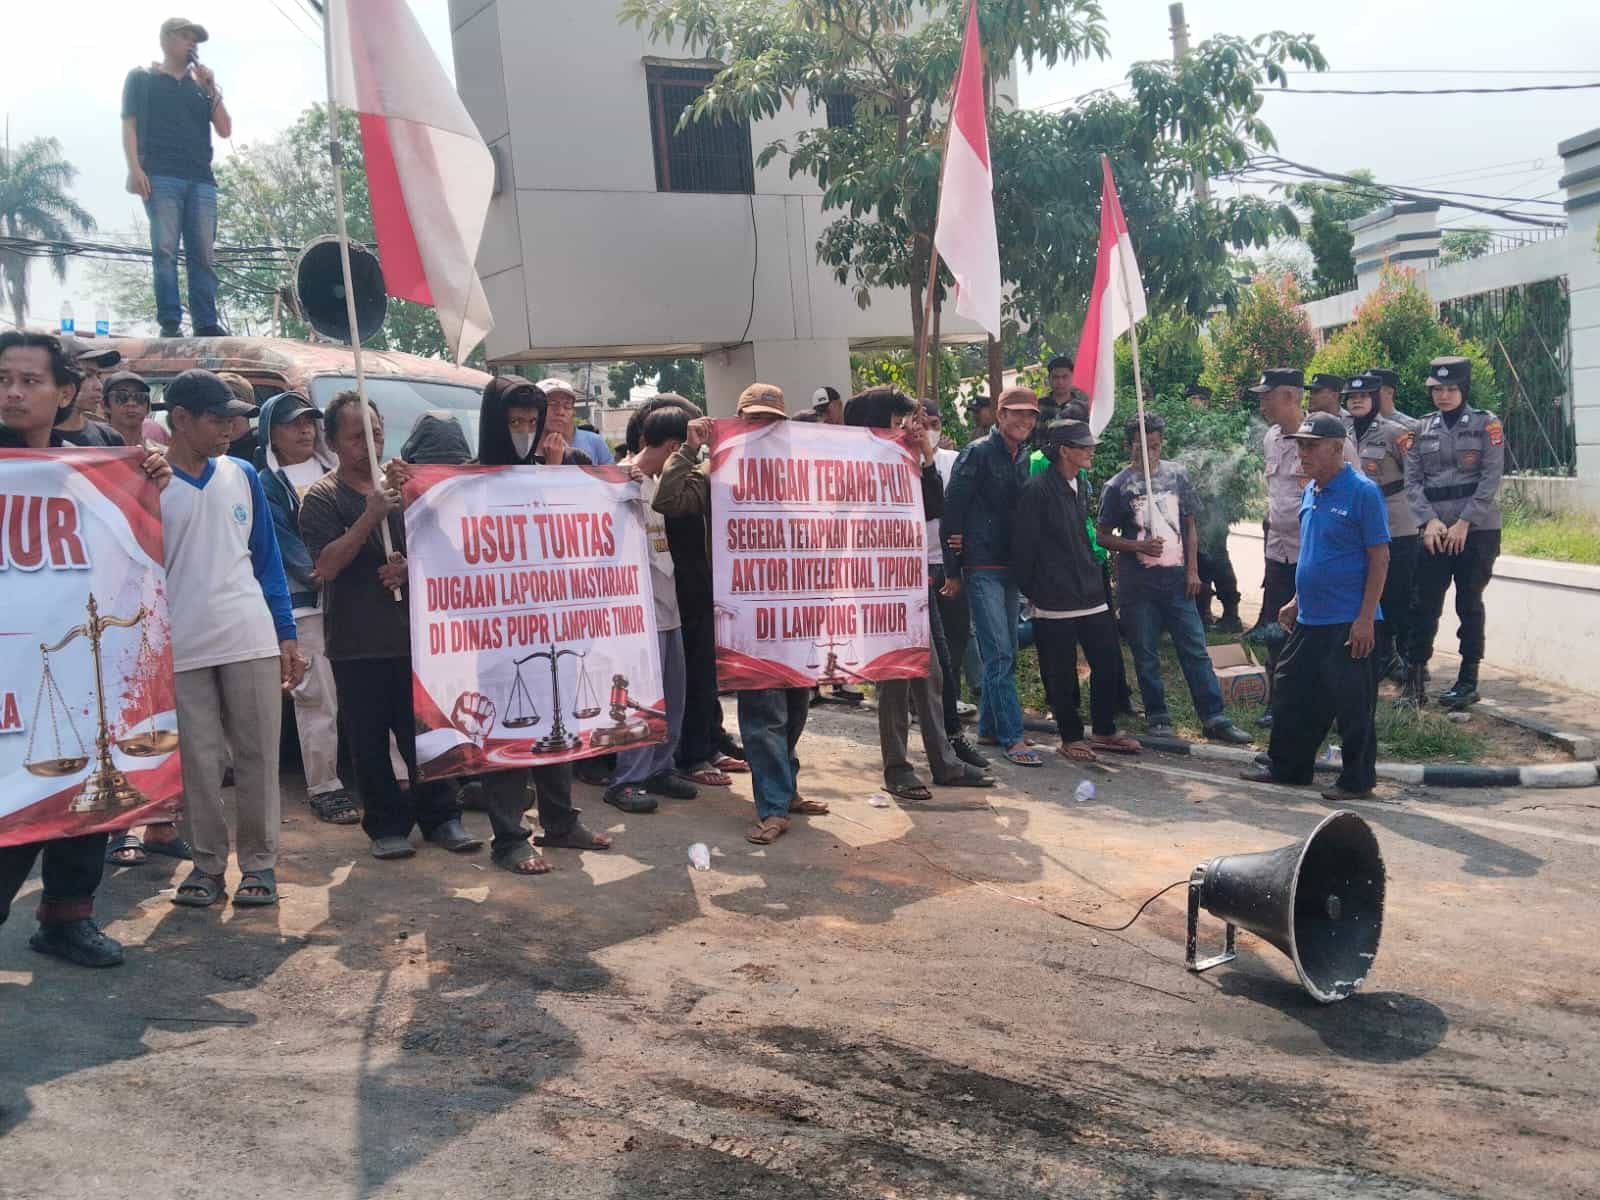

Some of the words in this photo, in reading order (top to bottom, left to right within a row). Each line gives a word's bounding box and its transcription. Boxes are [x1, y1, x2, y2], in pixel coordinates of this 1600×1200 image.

[733, 458, 810, 501] JANGAN
[814, 460, 876, 502] TEBANG
[878, 462, 914, 503] PILIH
[461, 514, 527, 565] USUT
[533, 512, 616, 560] TUNTAS
[727, 518, 786, 550] SEGERA
[788, 519, 848, 549] TETAPKAN
[851, 518, 914, 549] TERSANGKA
[916, 521, 923, 548] &
[426, 574, 496, 612] DUGAAN
[500, 568, 567, 605] LAPORAN
[569, 565, 639, 600] MASYARAKAT
[731, 558, 788, 592] AKTOR
[792, 556, 874, 590] INTELEKTUAL
[877, 556, 922, 588] TIPIKOR
[429, 622, 445, 656] DI
[451, 618, 502, 654] DINAS
[507, 613, 550, 648] PUPR
[553, 608, 611, 642] LAMPUNG
[611, 605, 645, 636] TIMUR
[756, 607, 776, 640] DI
[782, 604, 856, 639] LAMPUNG
[861, 602, 907, 634] TIMUR
